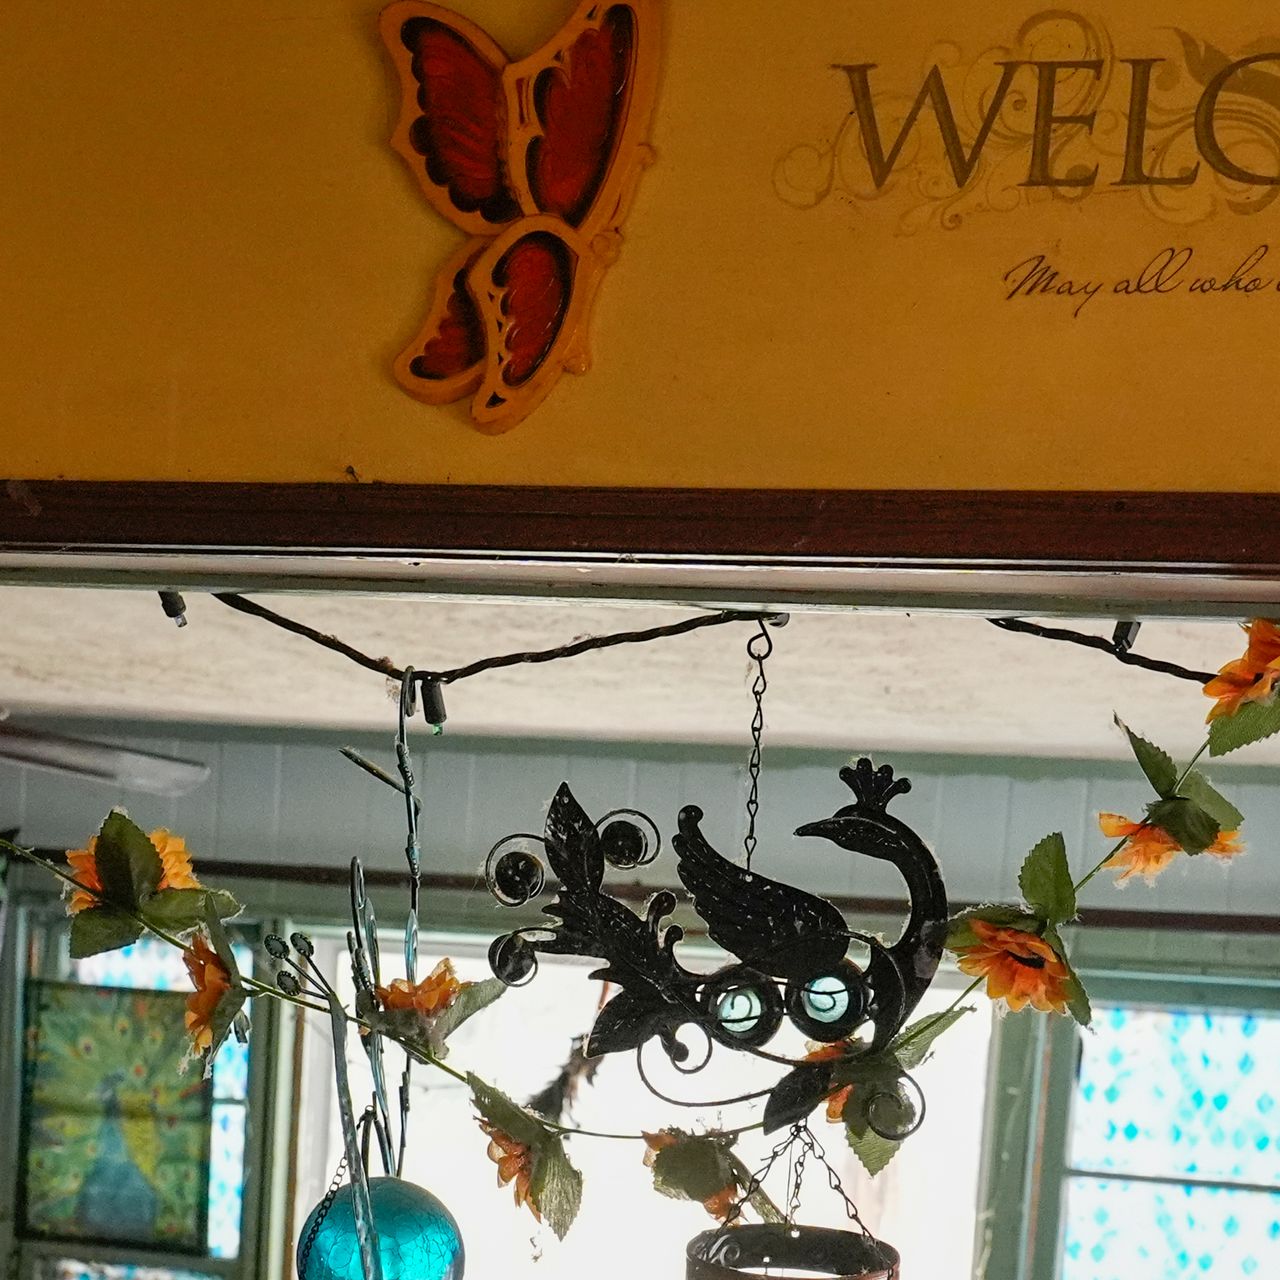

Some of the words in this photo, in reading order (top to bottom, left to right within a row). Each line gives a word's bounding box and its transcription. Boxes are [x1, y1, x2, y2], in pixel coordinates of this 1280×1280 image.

[1004, 255, 1104, 318] May
[1113, 247, 1193, 295] all
[1189, 245, 1271, 293] who
